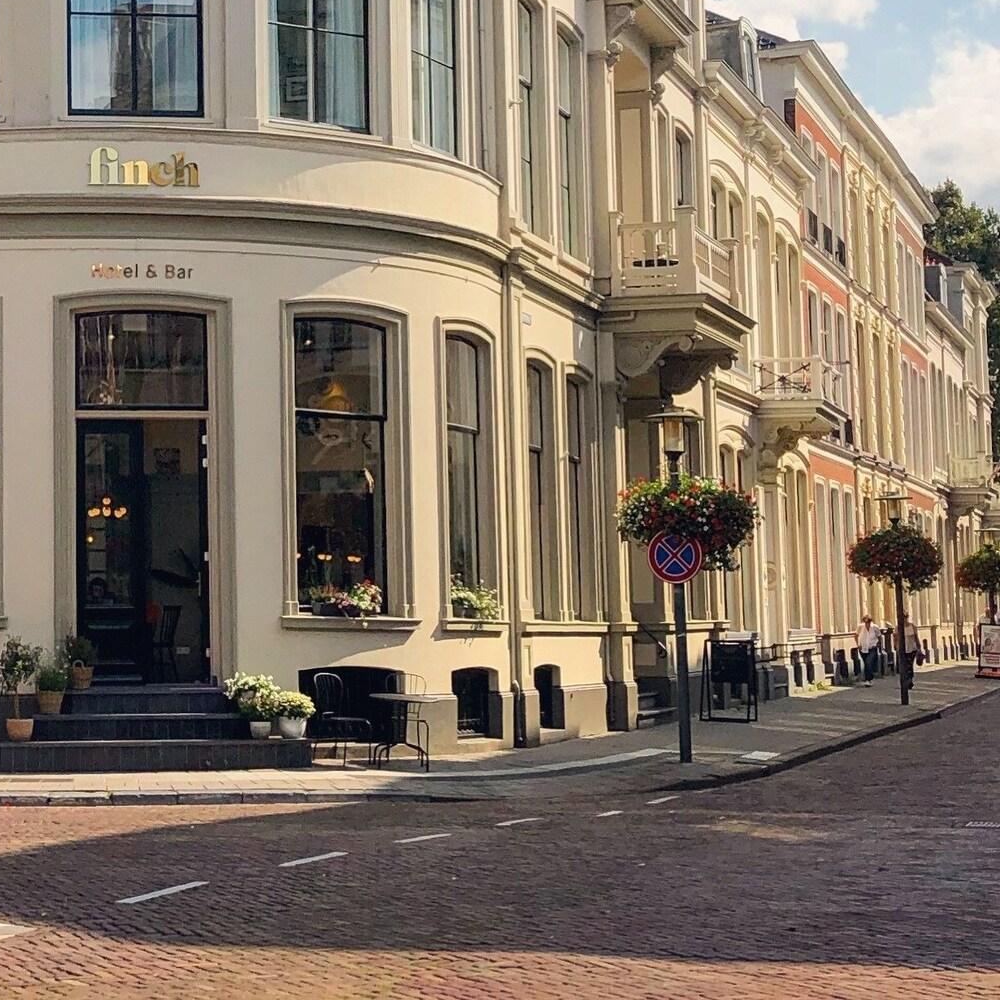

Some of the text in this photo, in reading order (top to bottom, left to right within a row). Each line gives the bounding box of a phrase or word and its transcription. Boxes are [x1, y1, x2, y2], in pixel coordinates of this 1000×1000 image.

[88, 146, 200, 187] finch
[91, 263, 194, 279] Hotel & Bar
